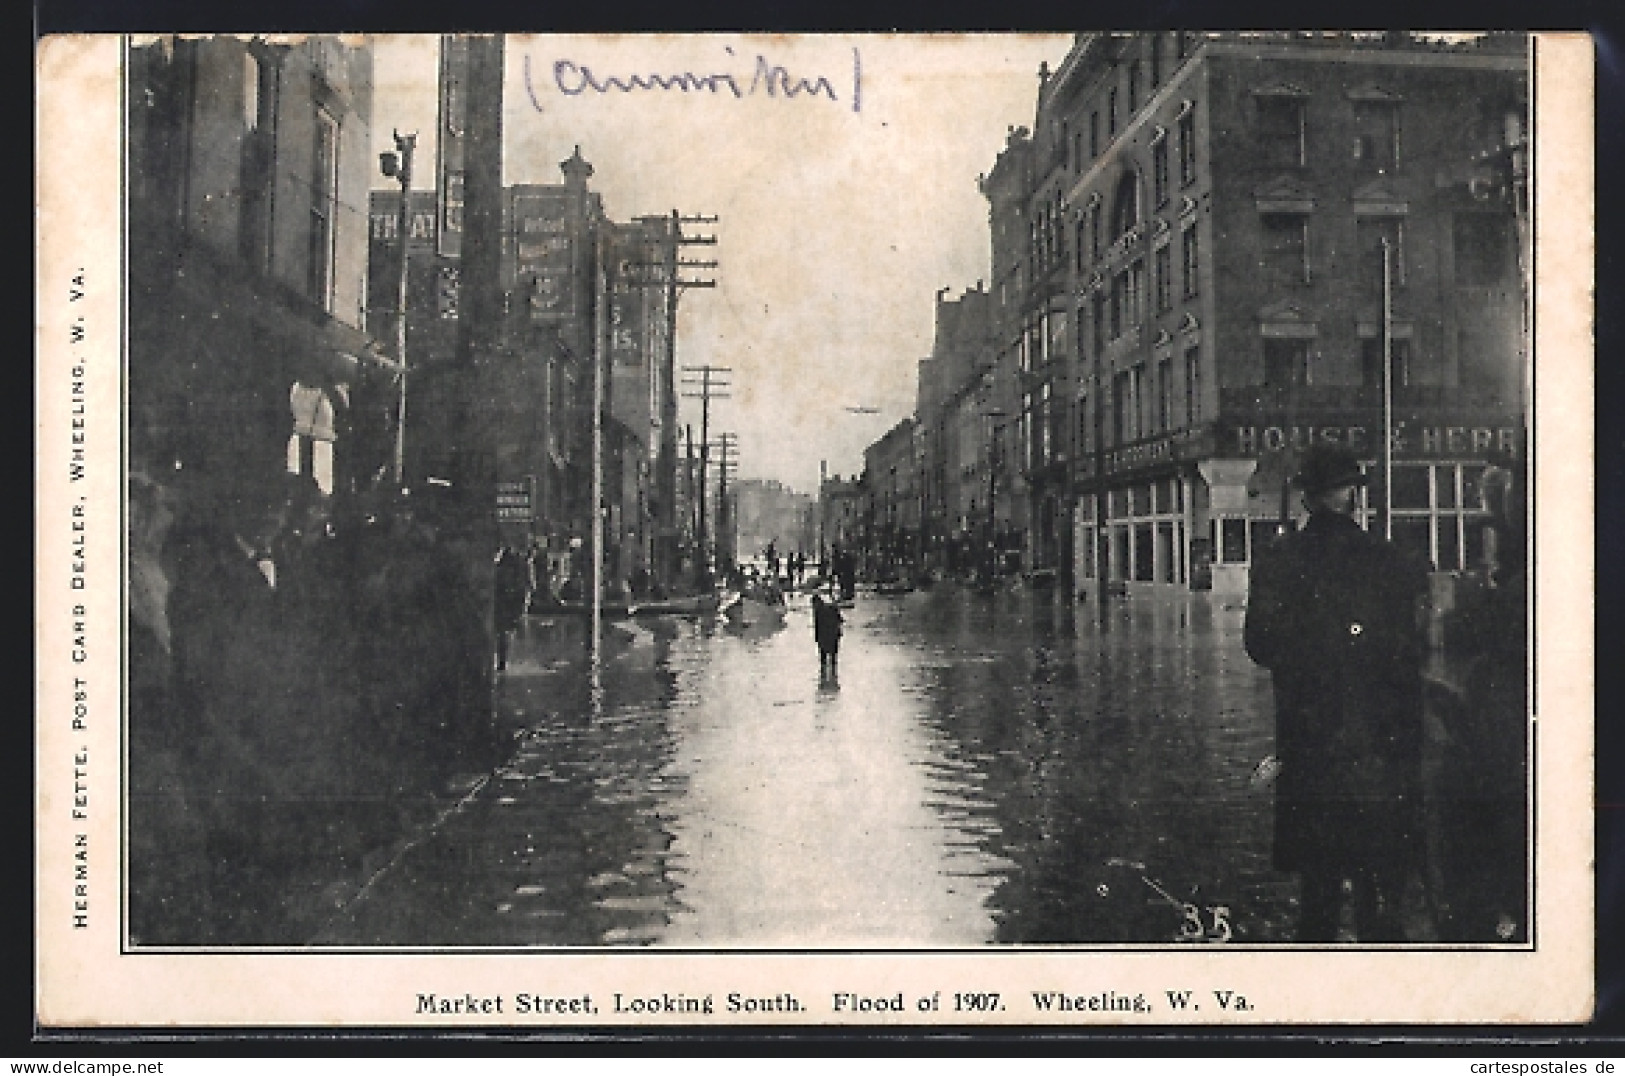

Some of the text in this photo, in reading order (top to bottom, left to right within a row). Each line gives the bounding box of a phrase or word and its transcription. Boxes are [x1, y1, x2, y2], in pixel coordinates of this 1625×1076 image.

[69, 267, 86, 302] VA.
[71, 317, 86, 344] W.
[1238, 426, 1366, 453] HOUSE
[72, 605, 87, 663] CARD
[72, 677, 87, 730] POST
[72, 834, 88, 928] HERMAN
[415, 990, 1255, 1014] Market Street, Looking South. Flood of 1907. Wheeling, W. Va.
